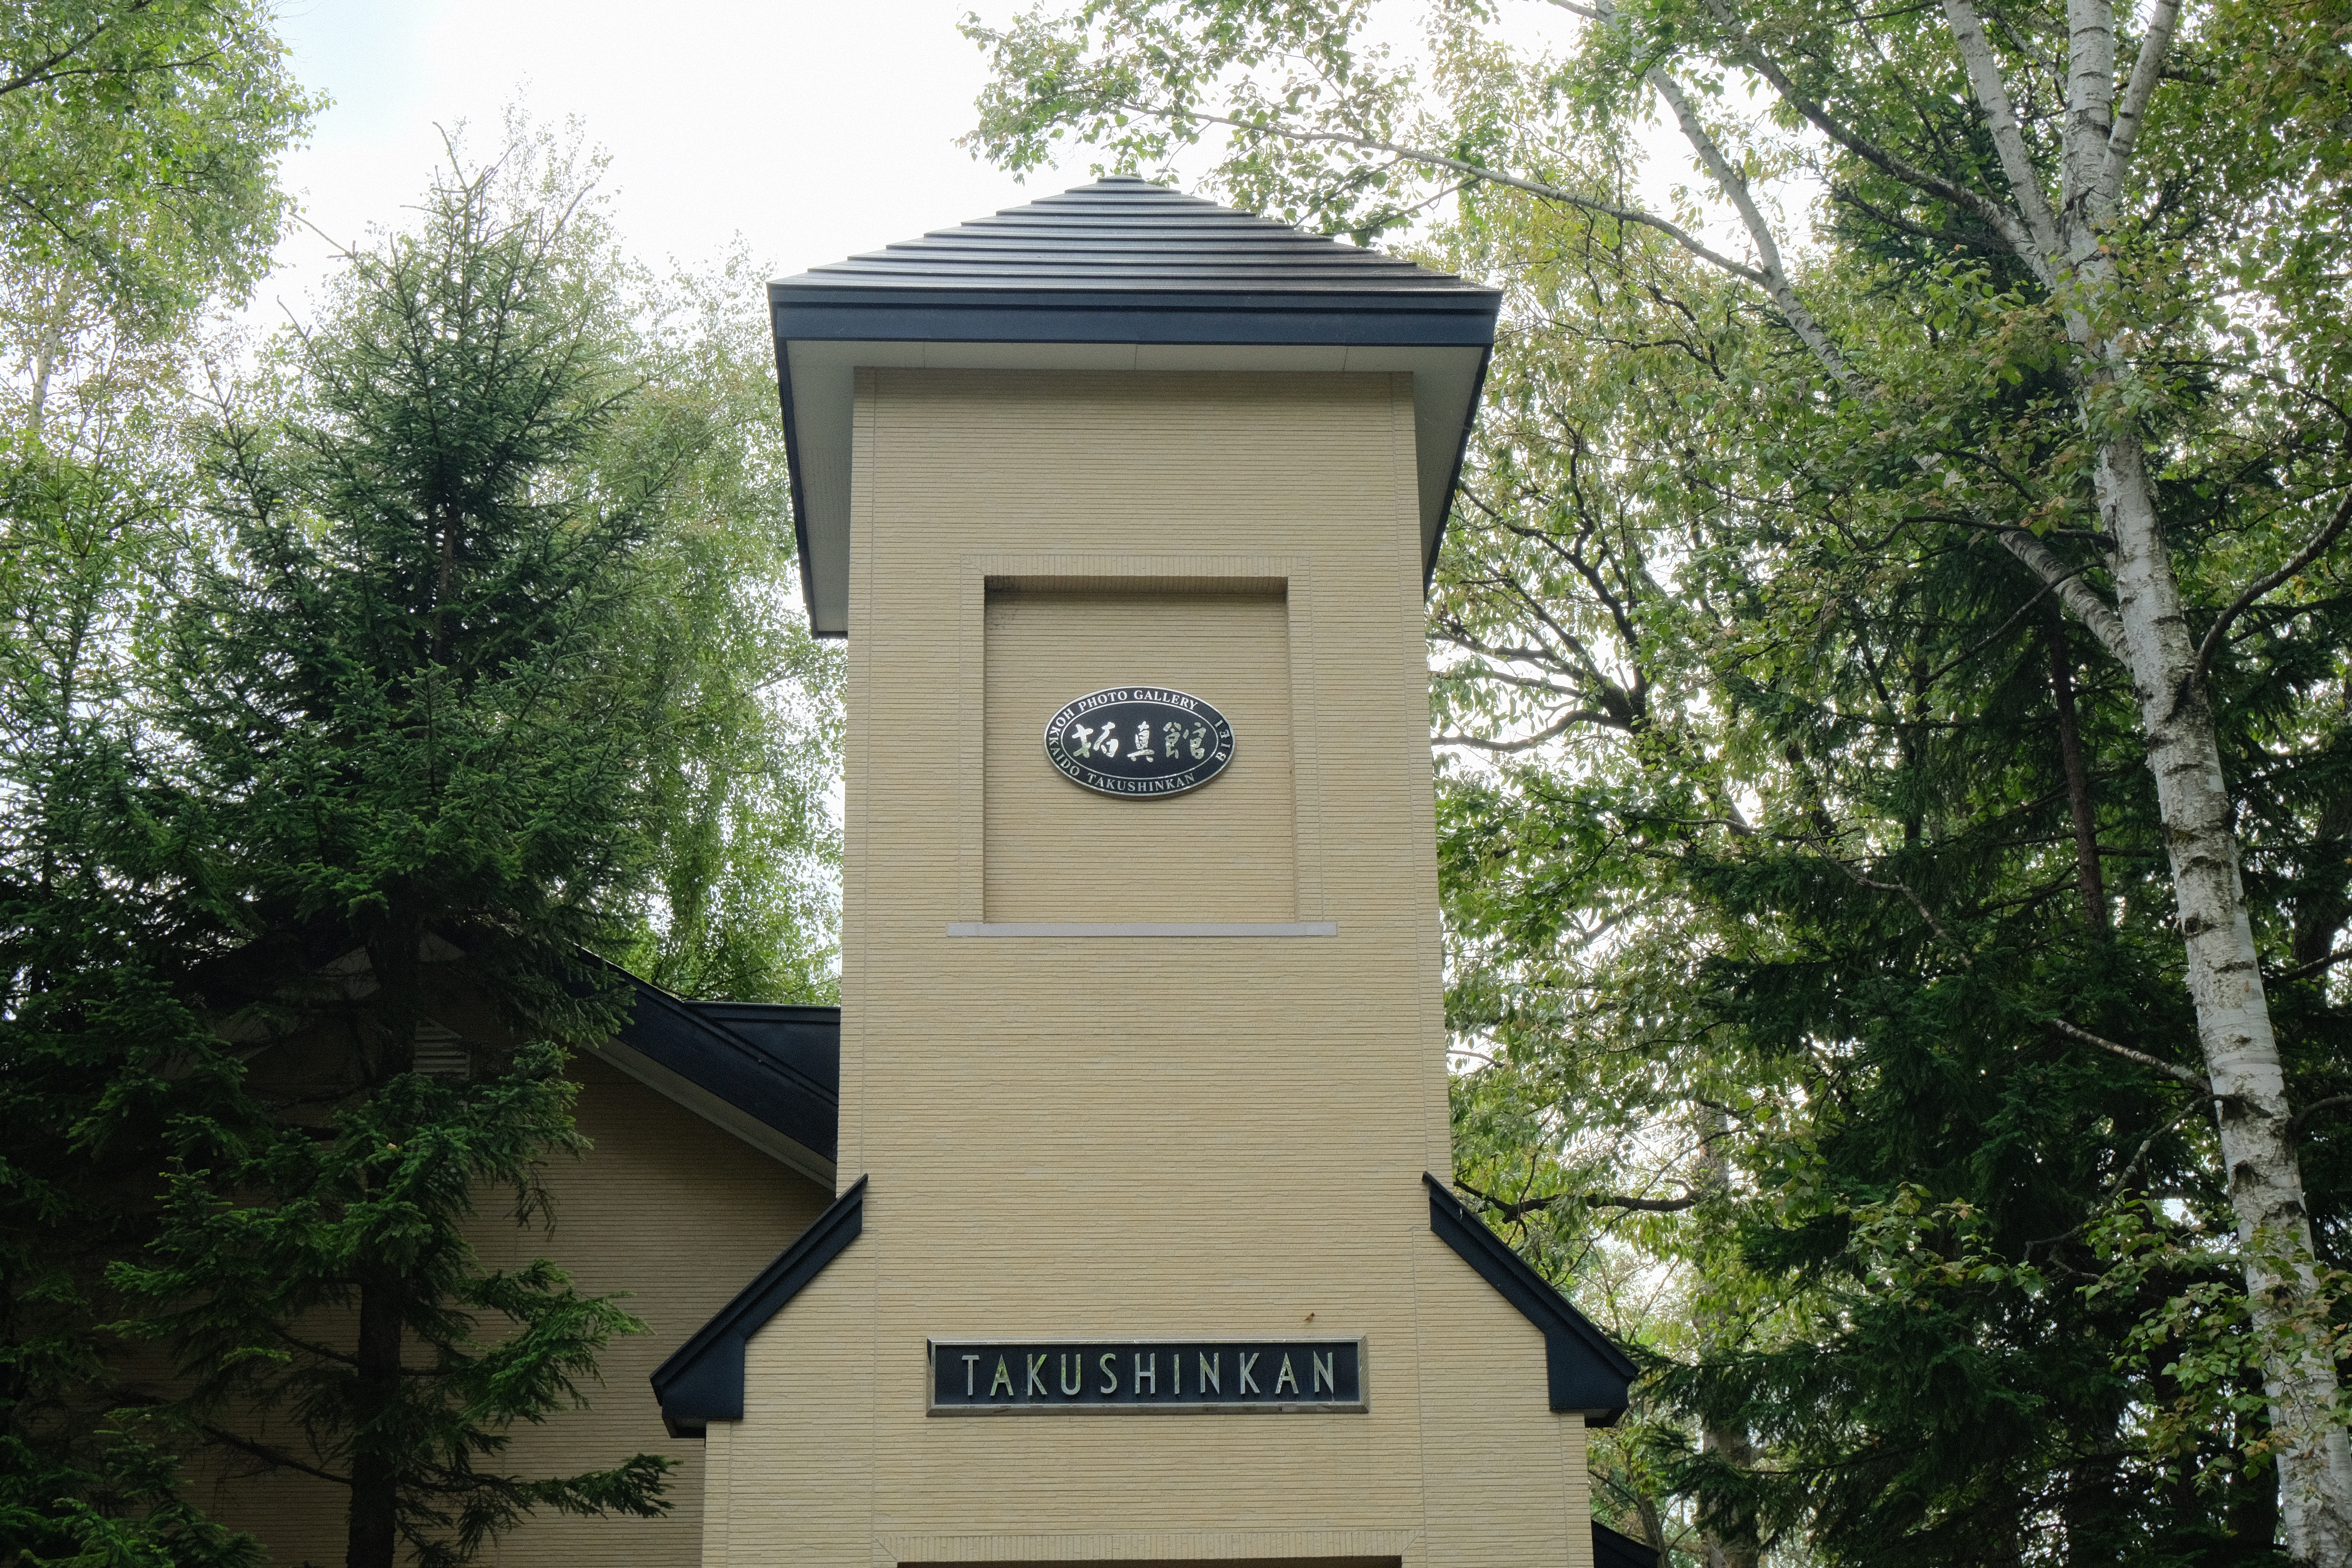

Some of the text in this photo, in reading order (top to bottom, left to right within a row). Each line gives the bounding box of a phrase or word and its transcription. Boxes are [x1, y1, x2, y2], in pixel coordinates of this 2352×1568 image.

[1078, 690, 1198, 712] PHOTO GALLERY
[1049, 708, 1230, 791] HOKKAIDO TAKUSHINKAN BIEI
[1071, 720, 1207, 762] 拓真館
[961, 1352, 1334, 1397] TAKUSHINKAN
